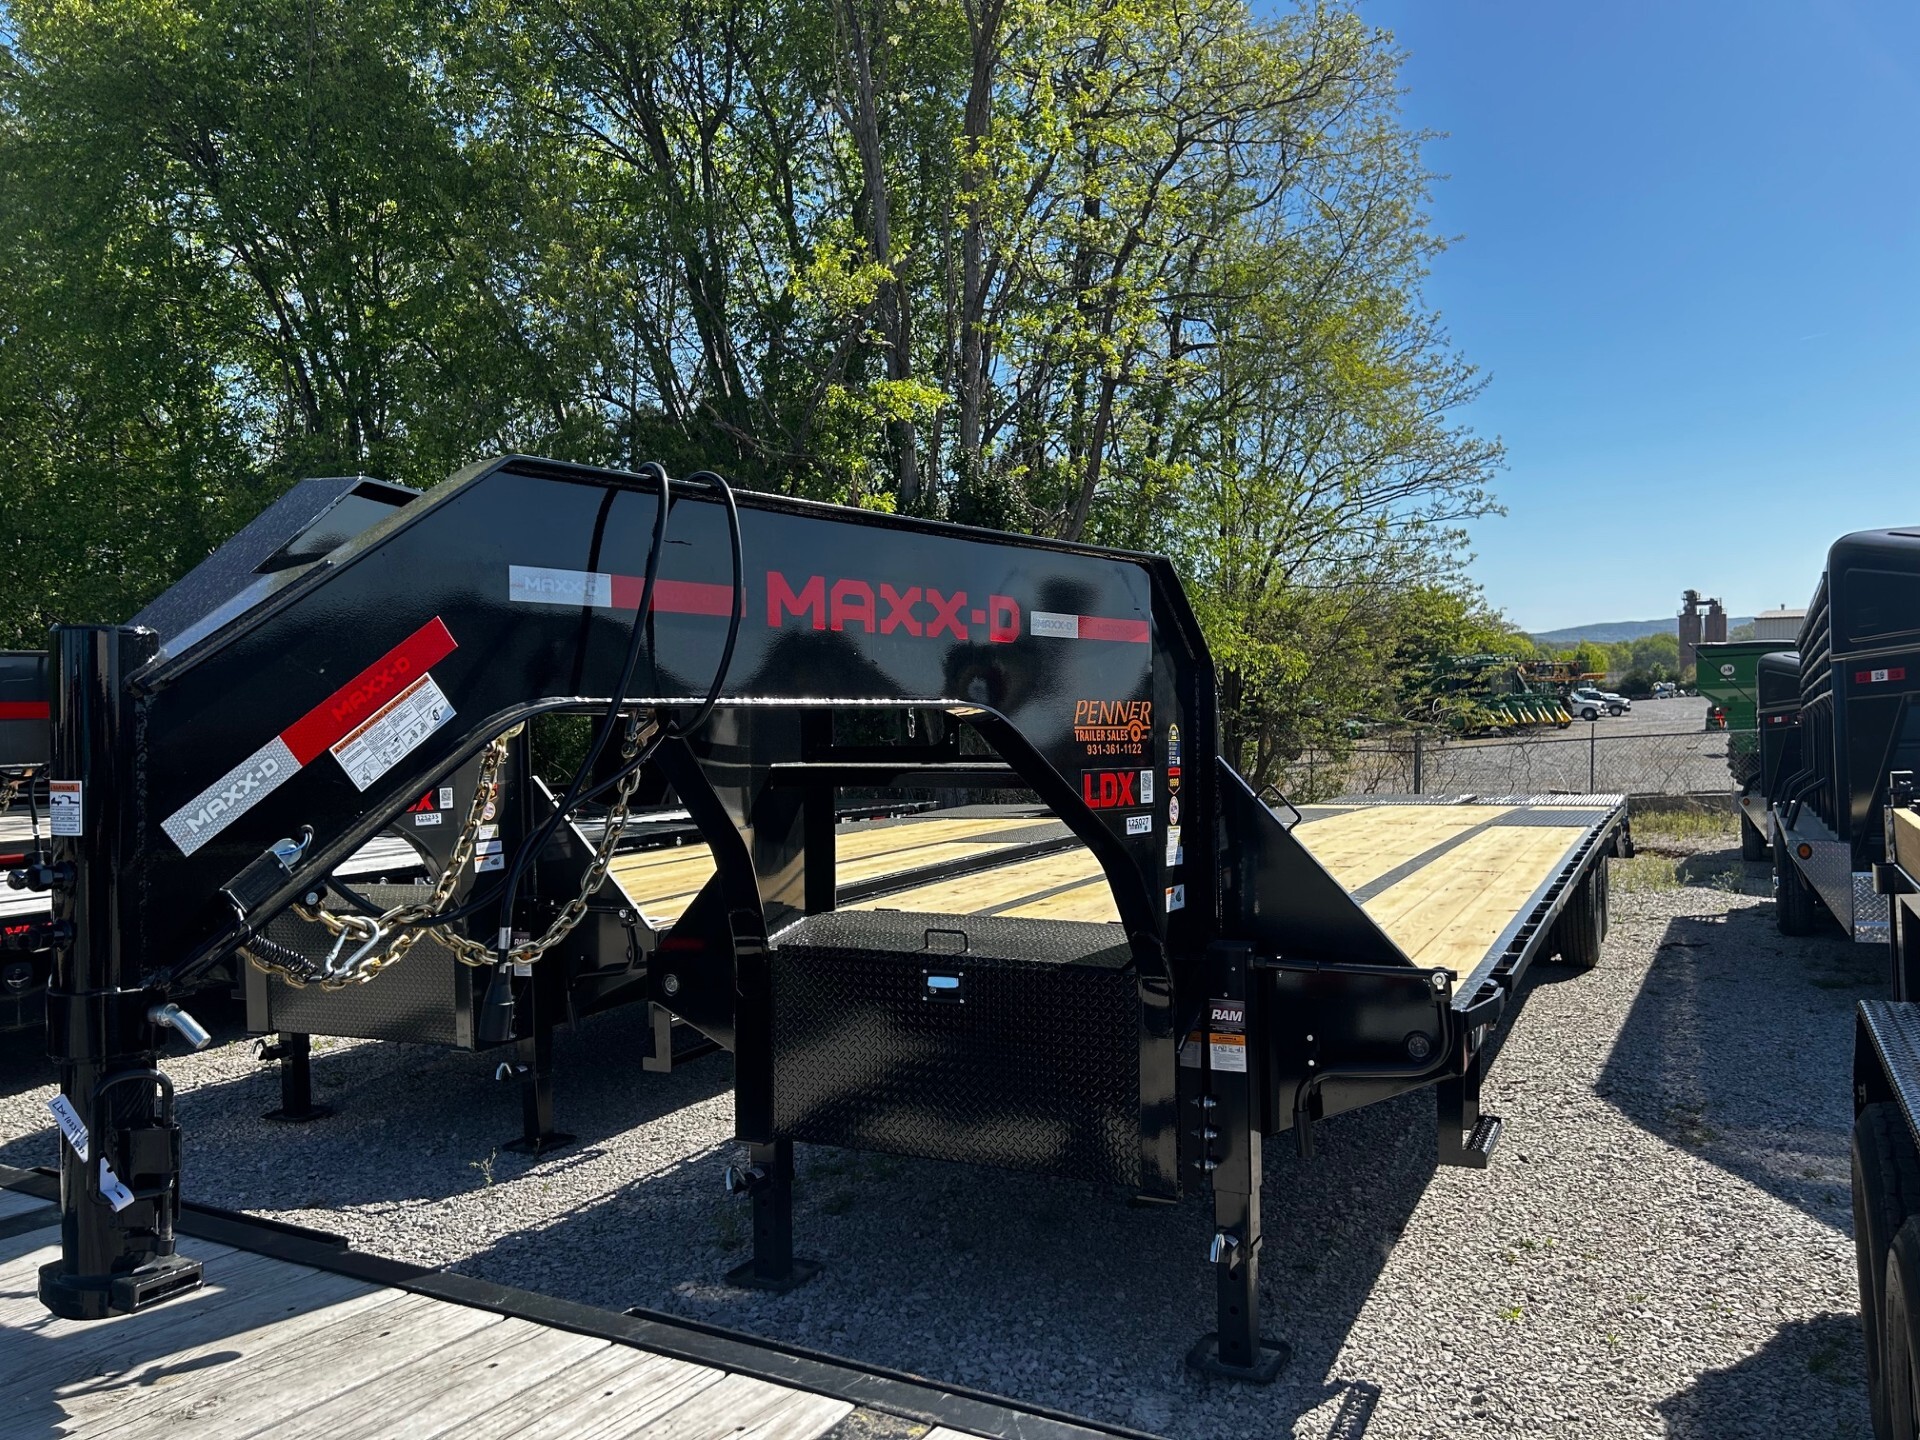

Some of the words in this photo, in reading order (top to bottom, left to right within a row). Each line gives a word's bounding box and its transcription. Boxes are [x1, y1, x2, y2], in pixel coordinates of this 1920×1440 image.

[524, 576, 599, 596] MAXX-D
[766, 571, 1020, 644] MAXX-D
[331, 657, 411, 721] MAXX-D
[1074, 700, 1152, 725] PENNER
[1075, 730, 1106, 742] TRAILER
[1107, 729, 1129, 742] SALES
[1086, 743, 1142, 755] 931-361-1122
[184, 758, 279, 835] MAXX-D
[1084, 772, 1135, 808] LDX
[1128, 817, 1149, 827] 125027
[1211, 1009, 1243, 1022] RAM
